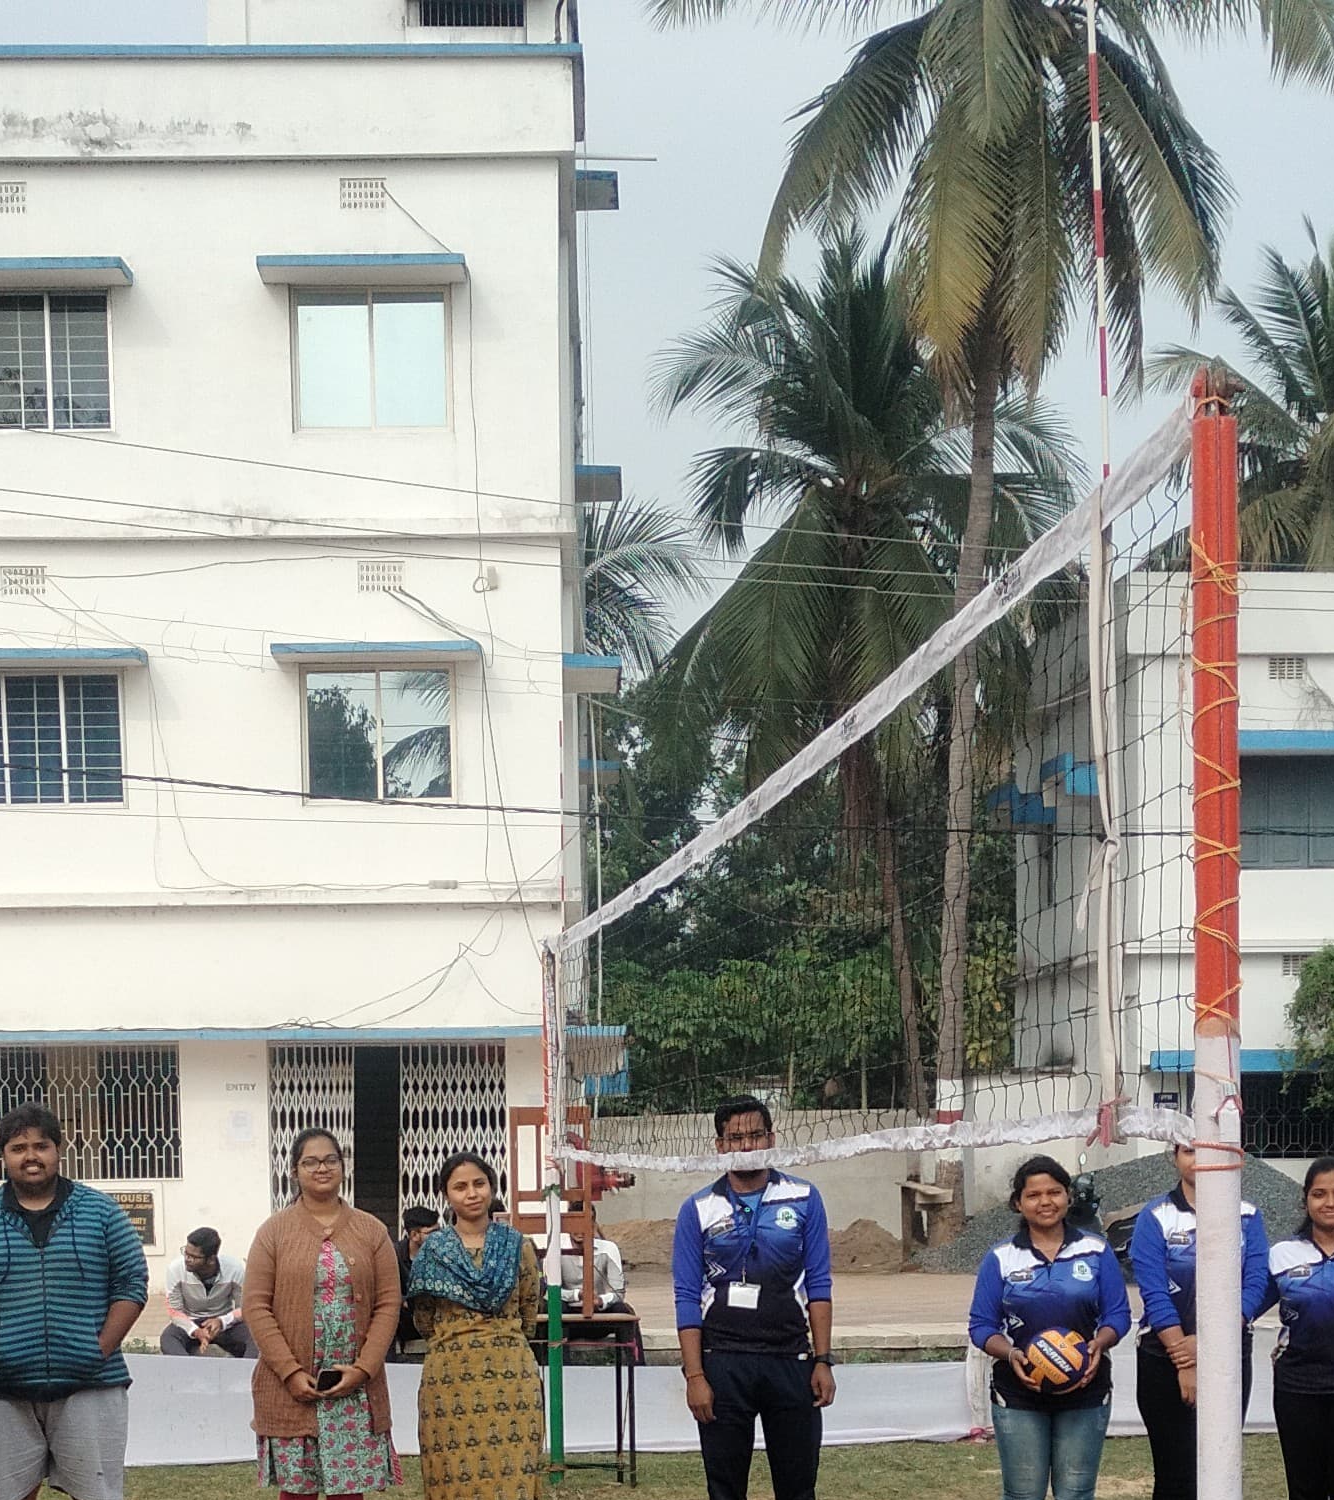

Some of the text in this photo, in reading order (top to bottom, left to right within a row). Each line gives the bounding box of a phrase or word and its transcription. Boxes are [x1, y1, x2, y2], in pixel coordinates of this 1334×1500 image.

[226, 1083, 257, 1092] ENTRY
[113, 1194, 150, 1203] HOUSE
[1036, 1339, 1073, 1373] SPARTAN
